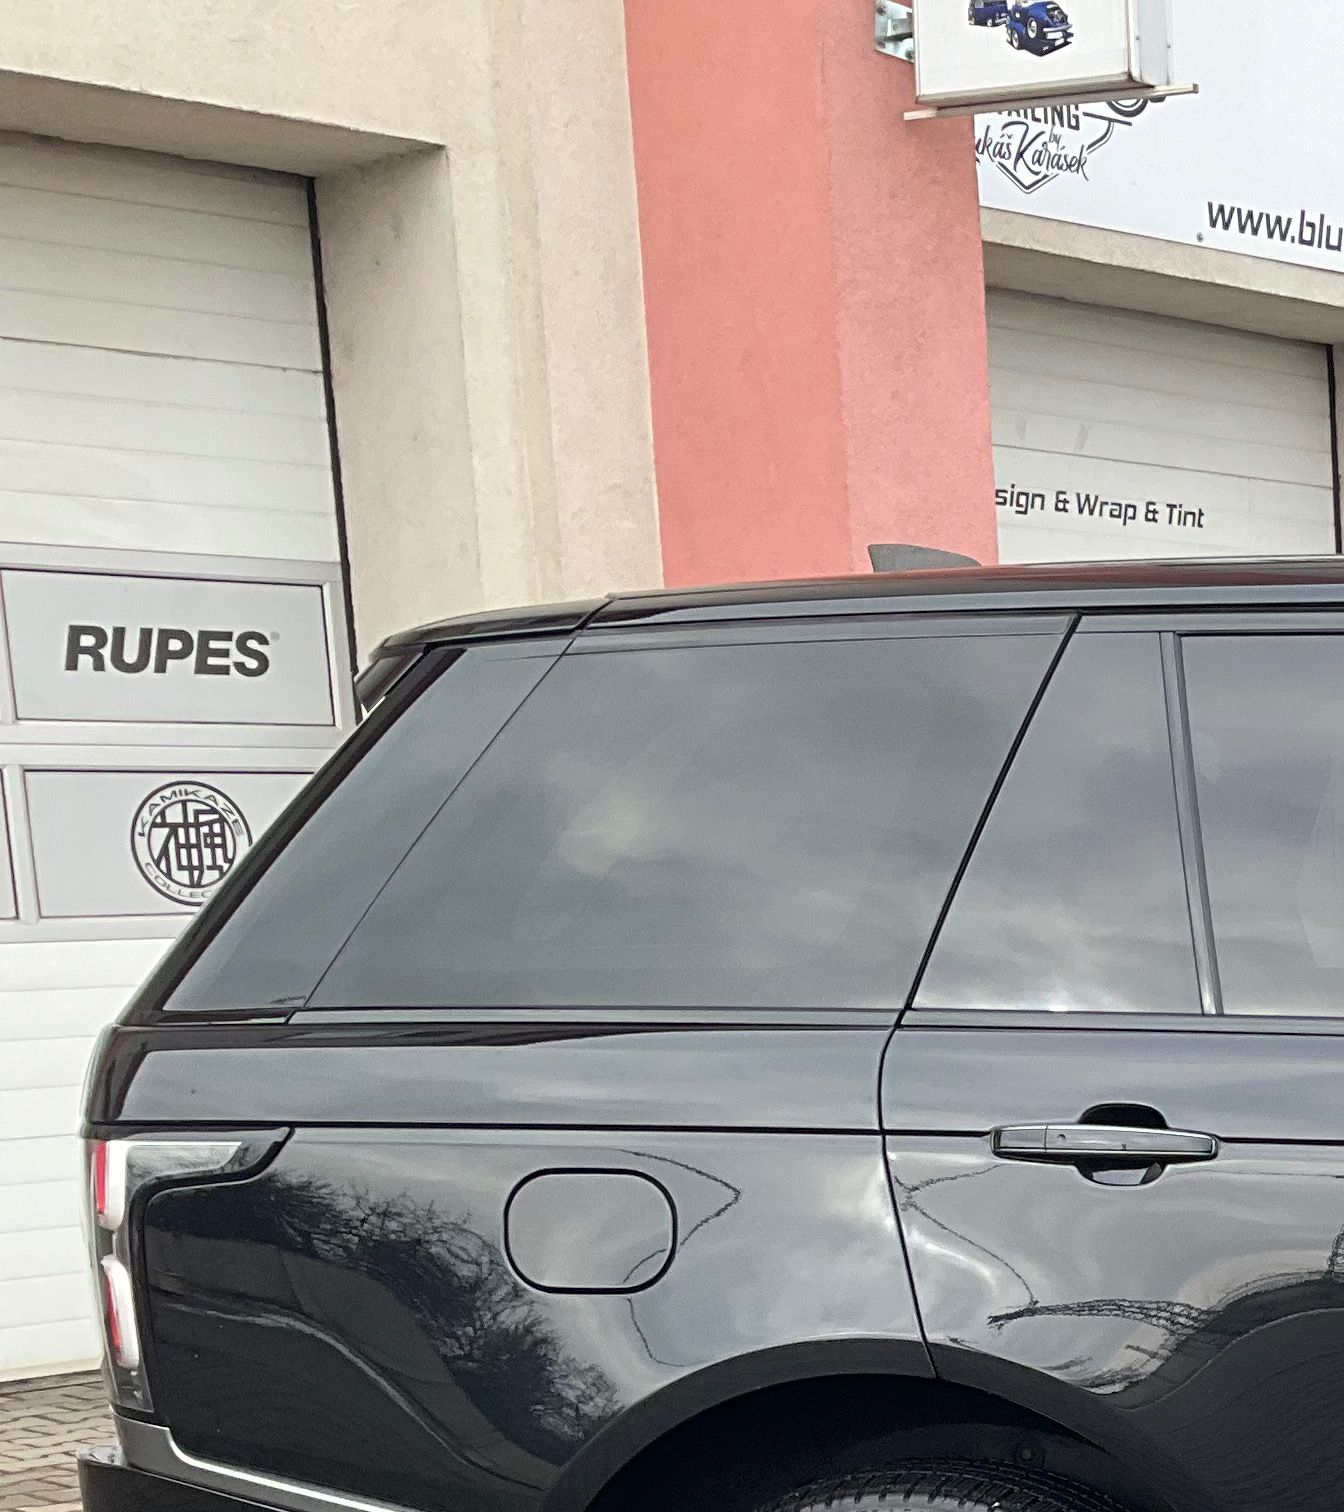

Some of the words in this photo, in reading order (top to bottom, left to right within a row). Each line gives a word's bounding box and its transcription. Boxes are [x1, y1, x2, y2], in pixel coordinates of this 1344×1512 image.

[975, 125, 1012, 162] ukáš
[1001, 120, 1089, 181] Karásek
[995, 484, 1045, 515] sign
[1054, 491, 1069, 513] &
[1076, 492, 1137, 526] Wrap
[1144, 502, 1159, 523] &
[1166, 504, 1204, 528] Tint
[65, 624, 270, 677] RUPES
[138, 788, 244, 837] KAMIKAZE
